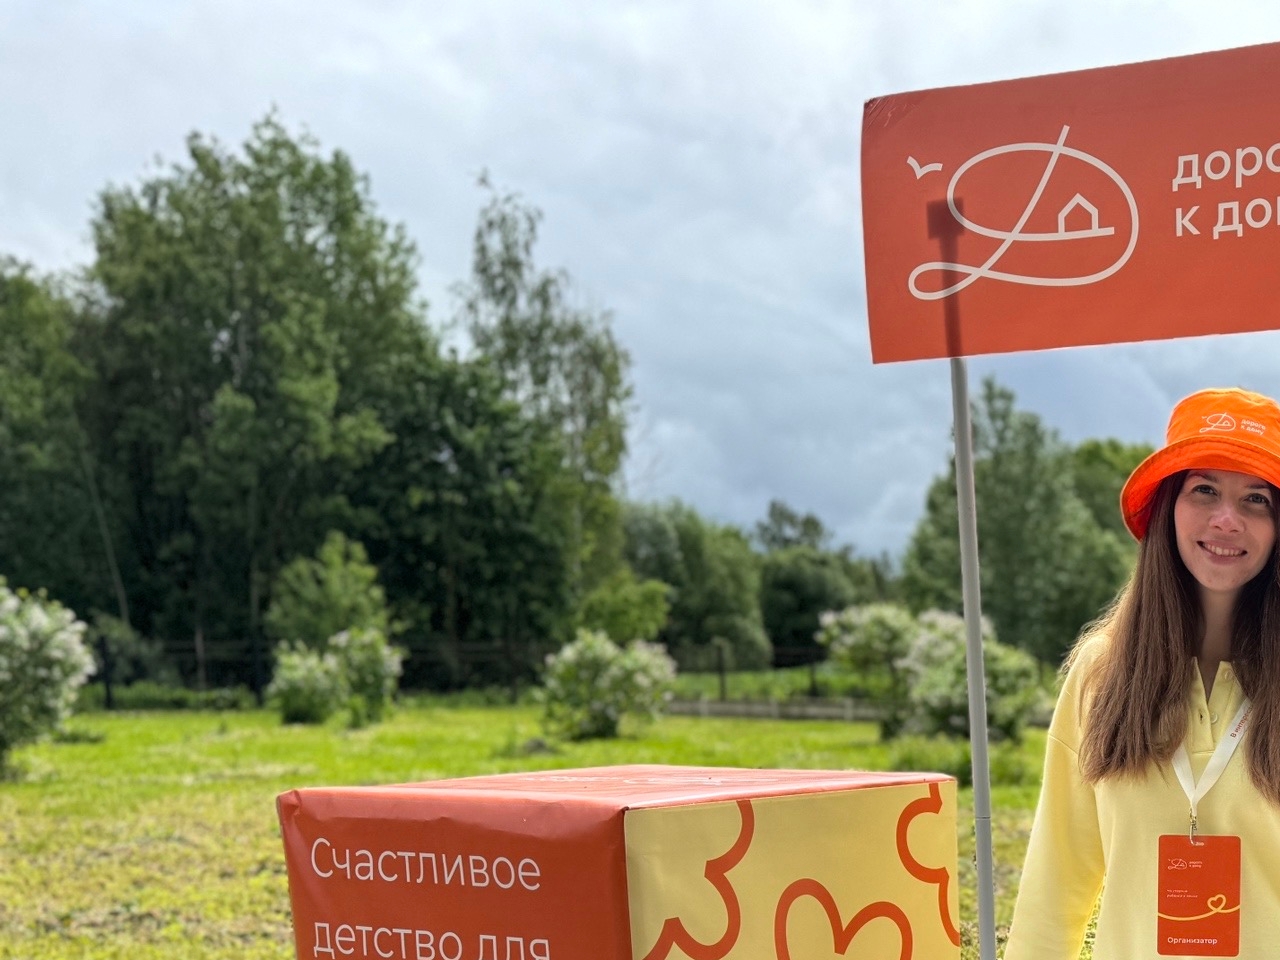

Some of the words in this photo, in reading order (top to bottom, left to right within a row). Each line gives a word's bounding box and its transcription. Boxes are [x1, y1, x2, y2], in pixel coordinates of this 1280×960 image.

[1175, 204, 1201, 237] к
[310, 837, 541, 891] Счастливое
[1167, 937, 1218, 945] Организатор
